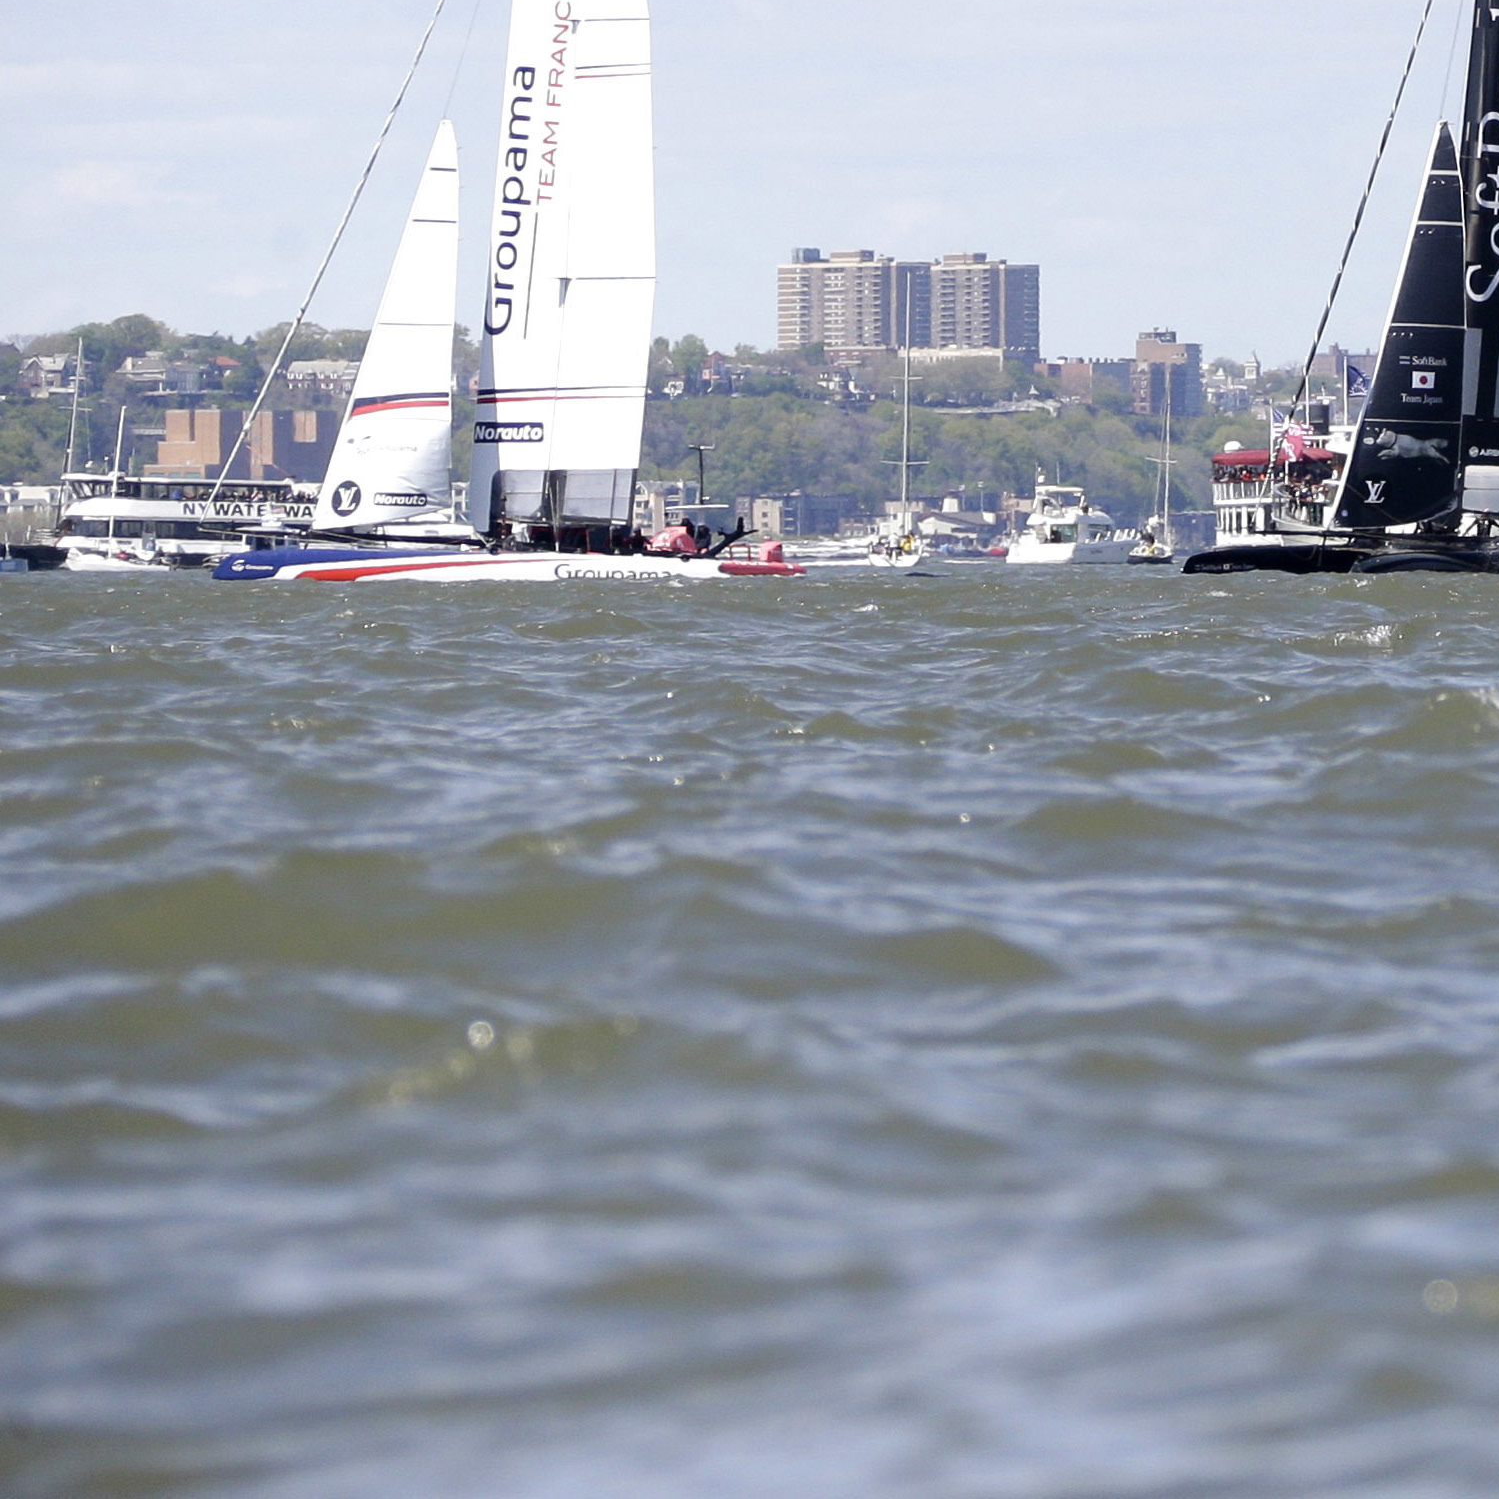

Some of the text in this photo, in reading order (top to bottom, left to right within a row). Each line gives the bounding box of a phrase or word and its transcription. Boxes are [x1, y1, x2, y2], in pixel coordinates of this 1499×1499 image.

[537, 121, 560, 206] TEAM
[484, 66, 536, 335] Groupama
[1412, 355, 1447, 366] SoftBank
[1401, 393, 1422, 403] Team
[475, 425, 543, 441] Norauto
[374, 493, 427, 506] Norauto
[183, 502, 317, 518] NY WATEWA
